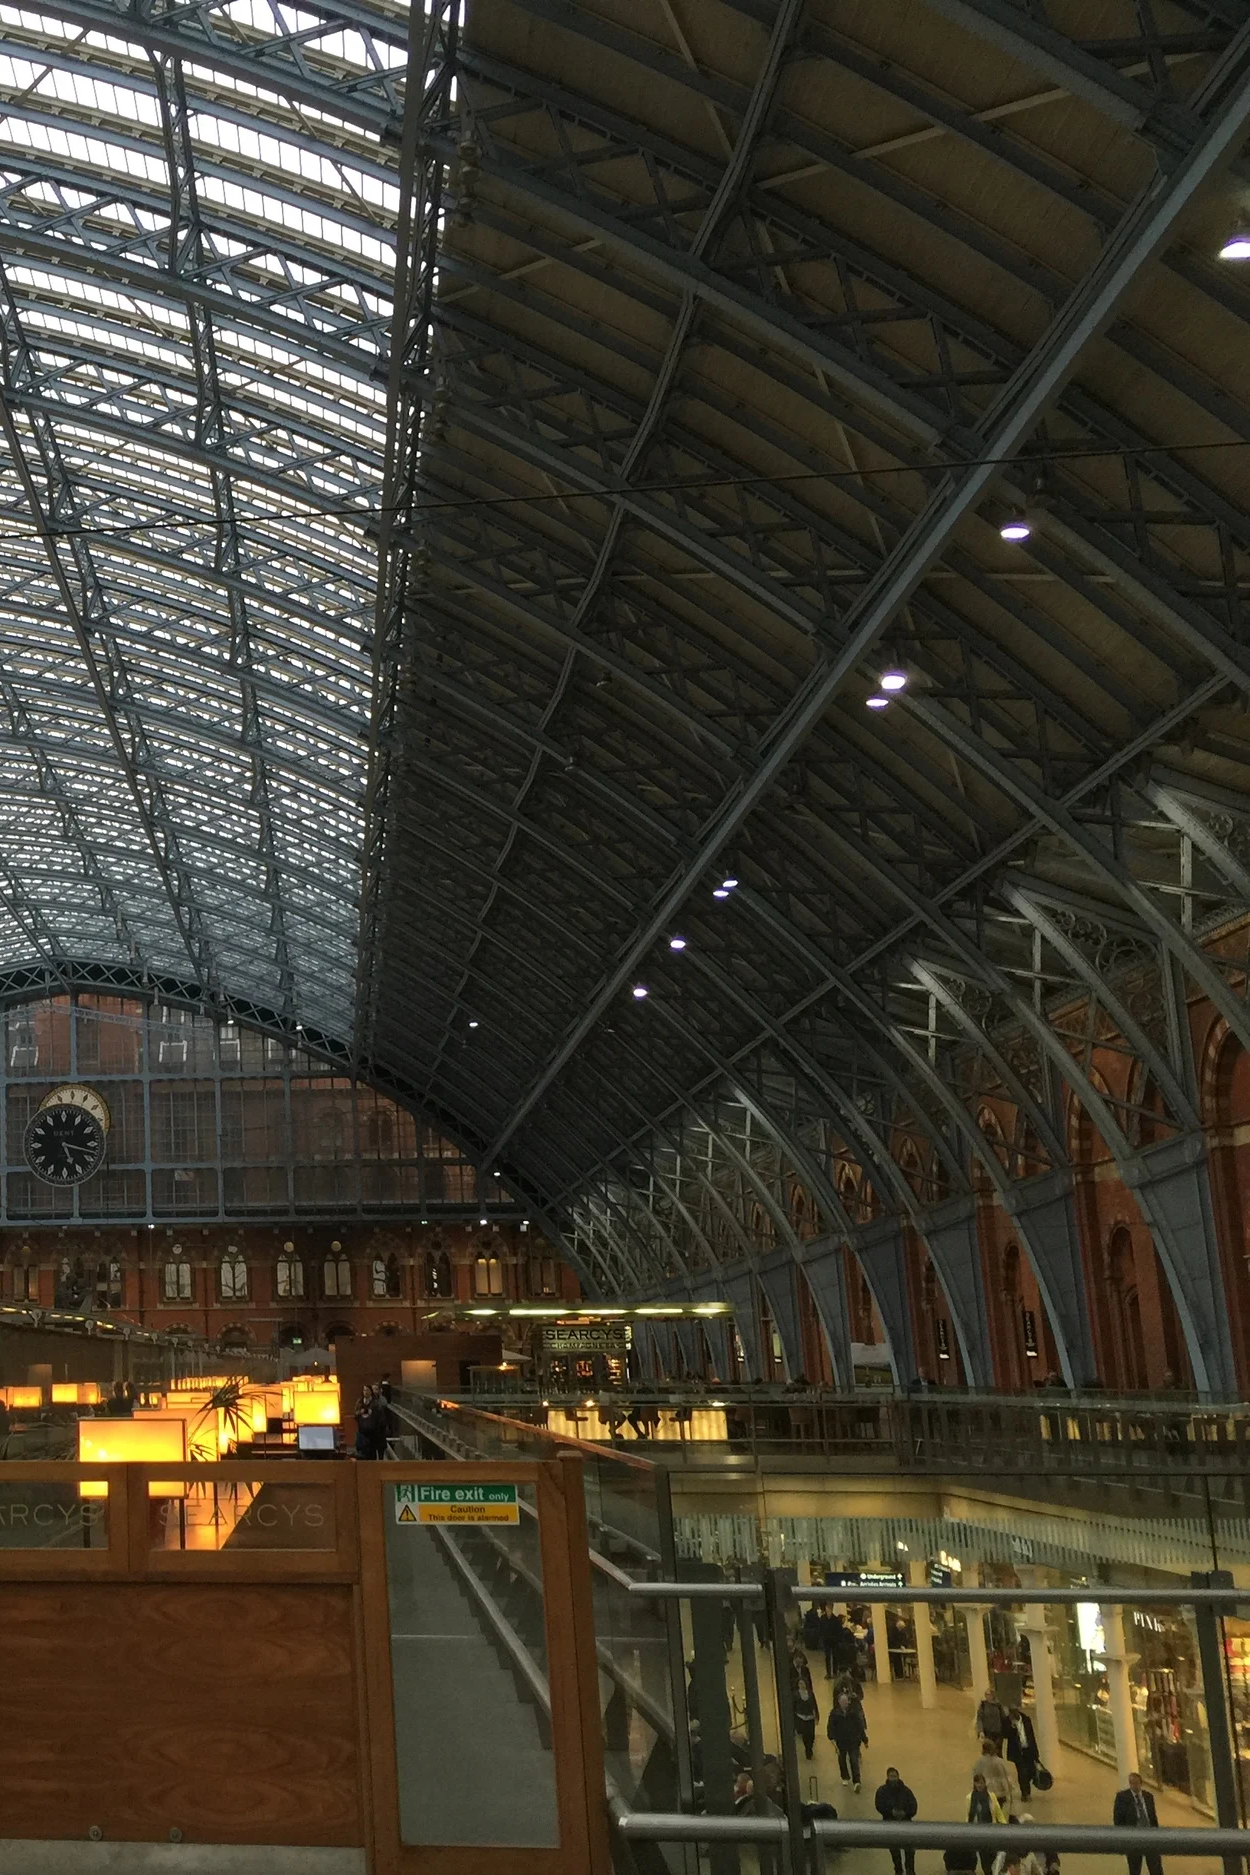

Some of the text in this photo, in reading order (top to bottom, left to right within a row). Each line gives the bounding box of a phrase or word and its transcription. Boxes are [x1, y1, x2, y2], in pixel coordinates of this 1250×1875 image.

[545, 1329, 624, 1341] SEARCYS
[420, 1486, 510, 1503] Fire exit only
[159, 1503, 325, 1527] SEARCYS
[450, 1504, 486, 1514] Caution
[428, 1513, 510, 1522] This door is alarmed
